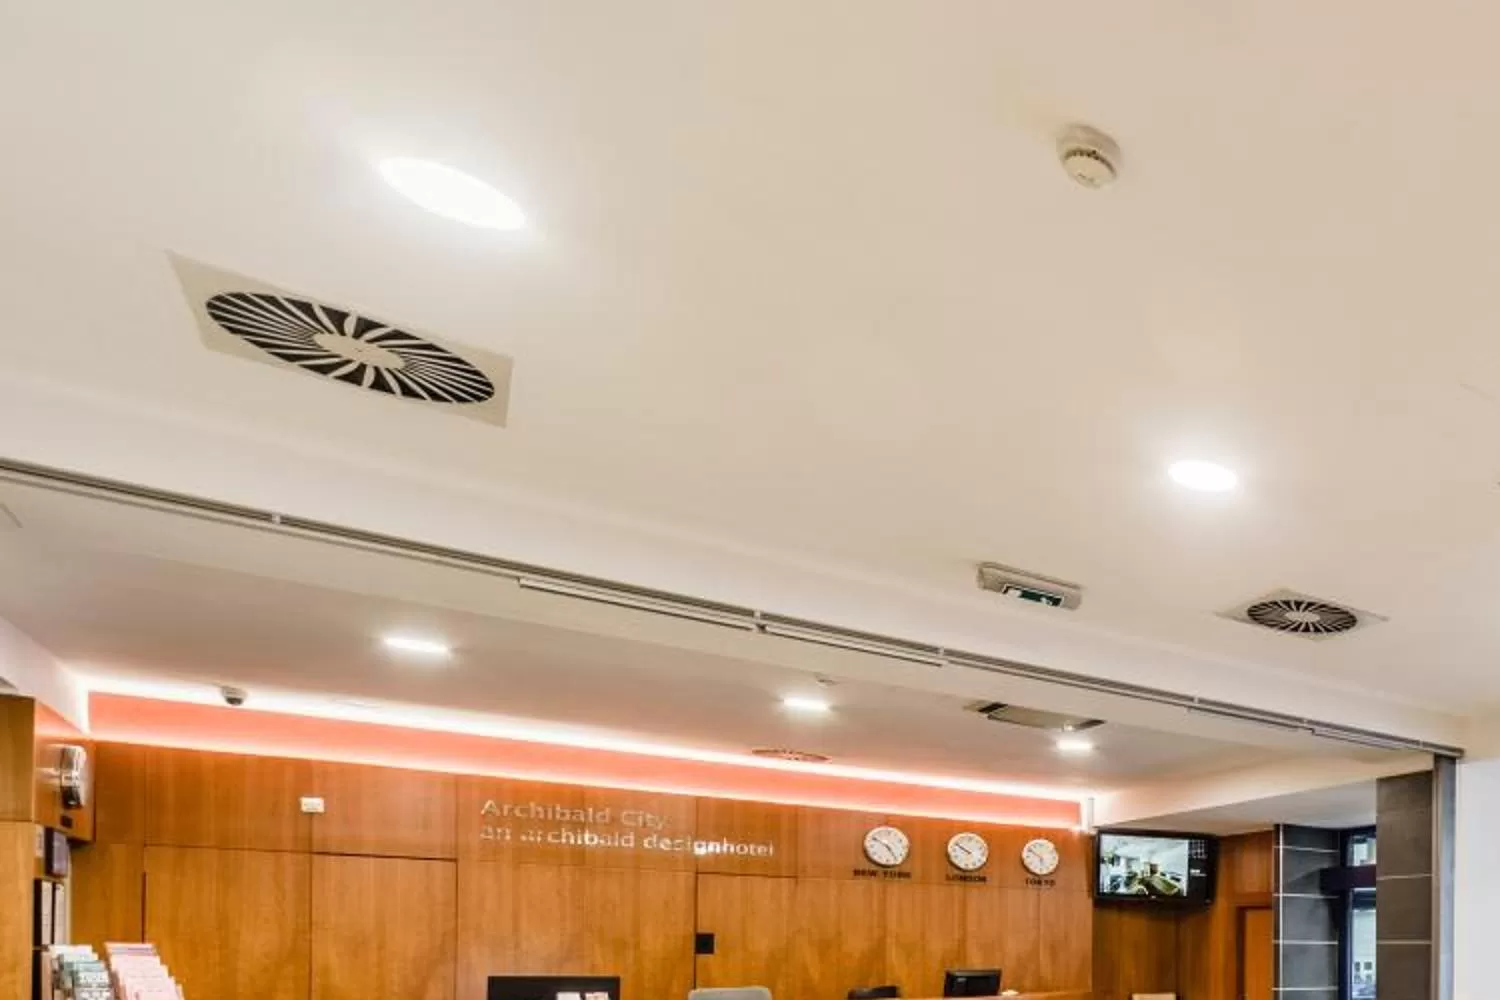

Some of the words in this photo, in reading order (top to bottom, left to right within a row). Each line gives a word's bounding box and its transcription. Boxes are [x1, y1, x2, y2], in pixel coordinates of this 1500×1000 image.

[480, 799, 611, 823] Archibald
[620, 809, 669, 830] City
[642, 833, 775, 857] designhotel
